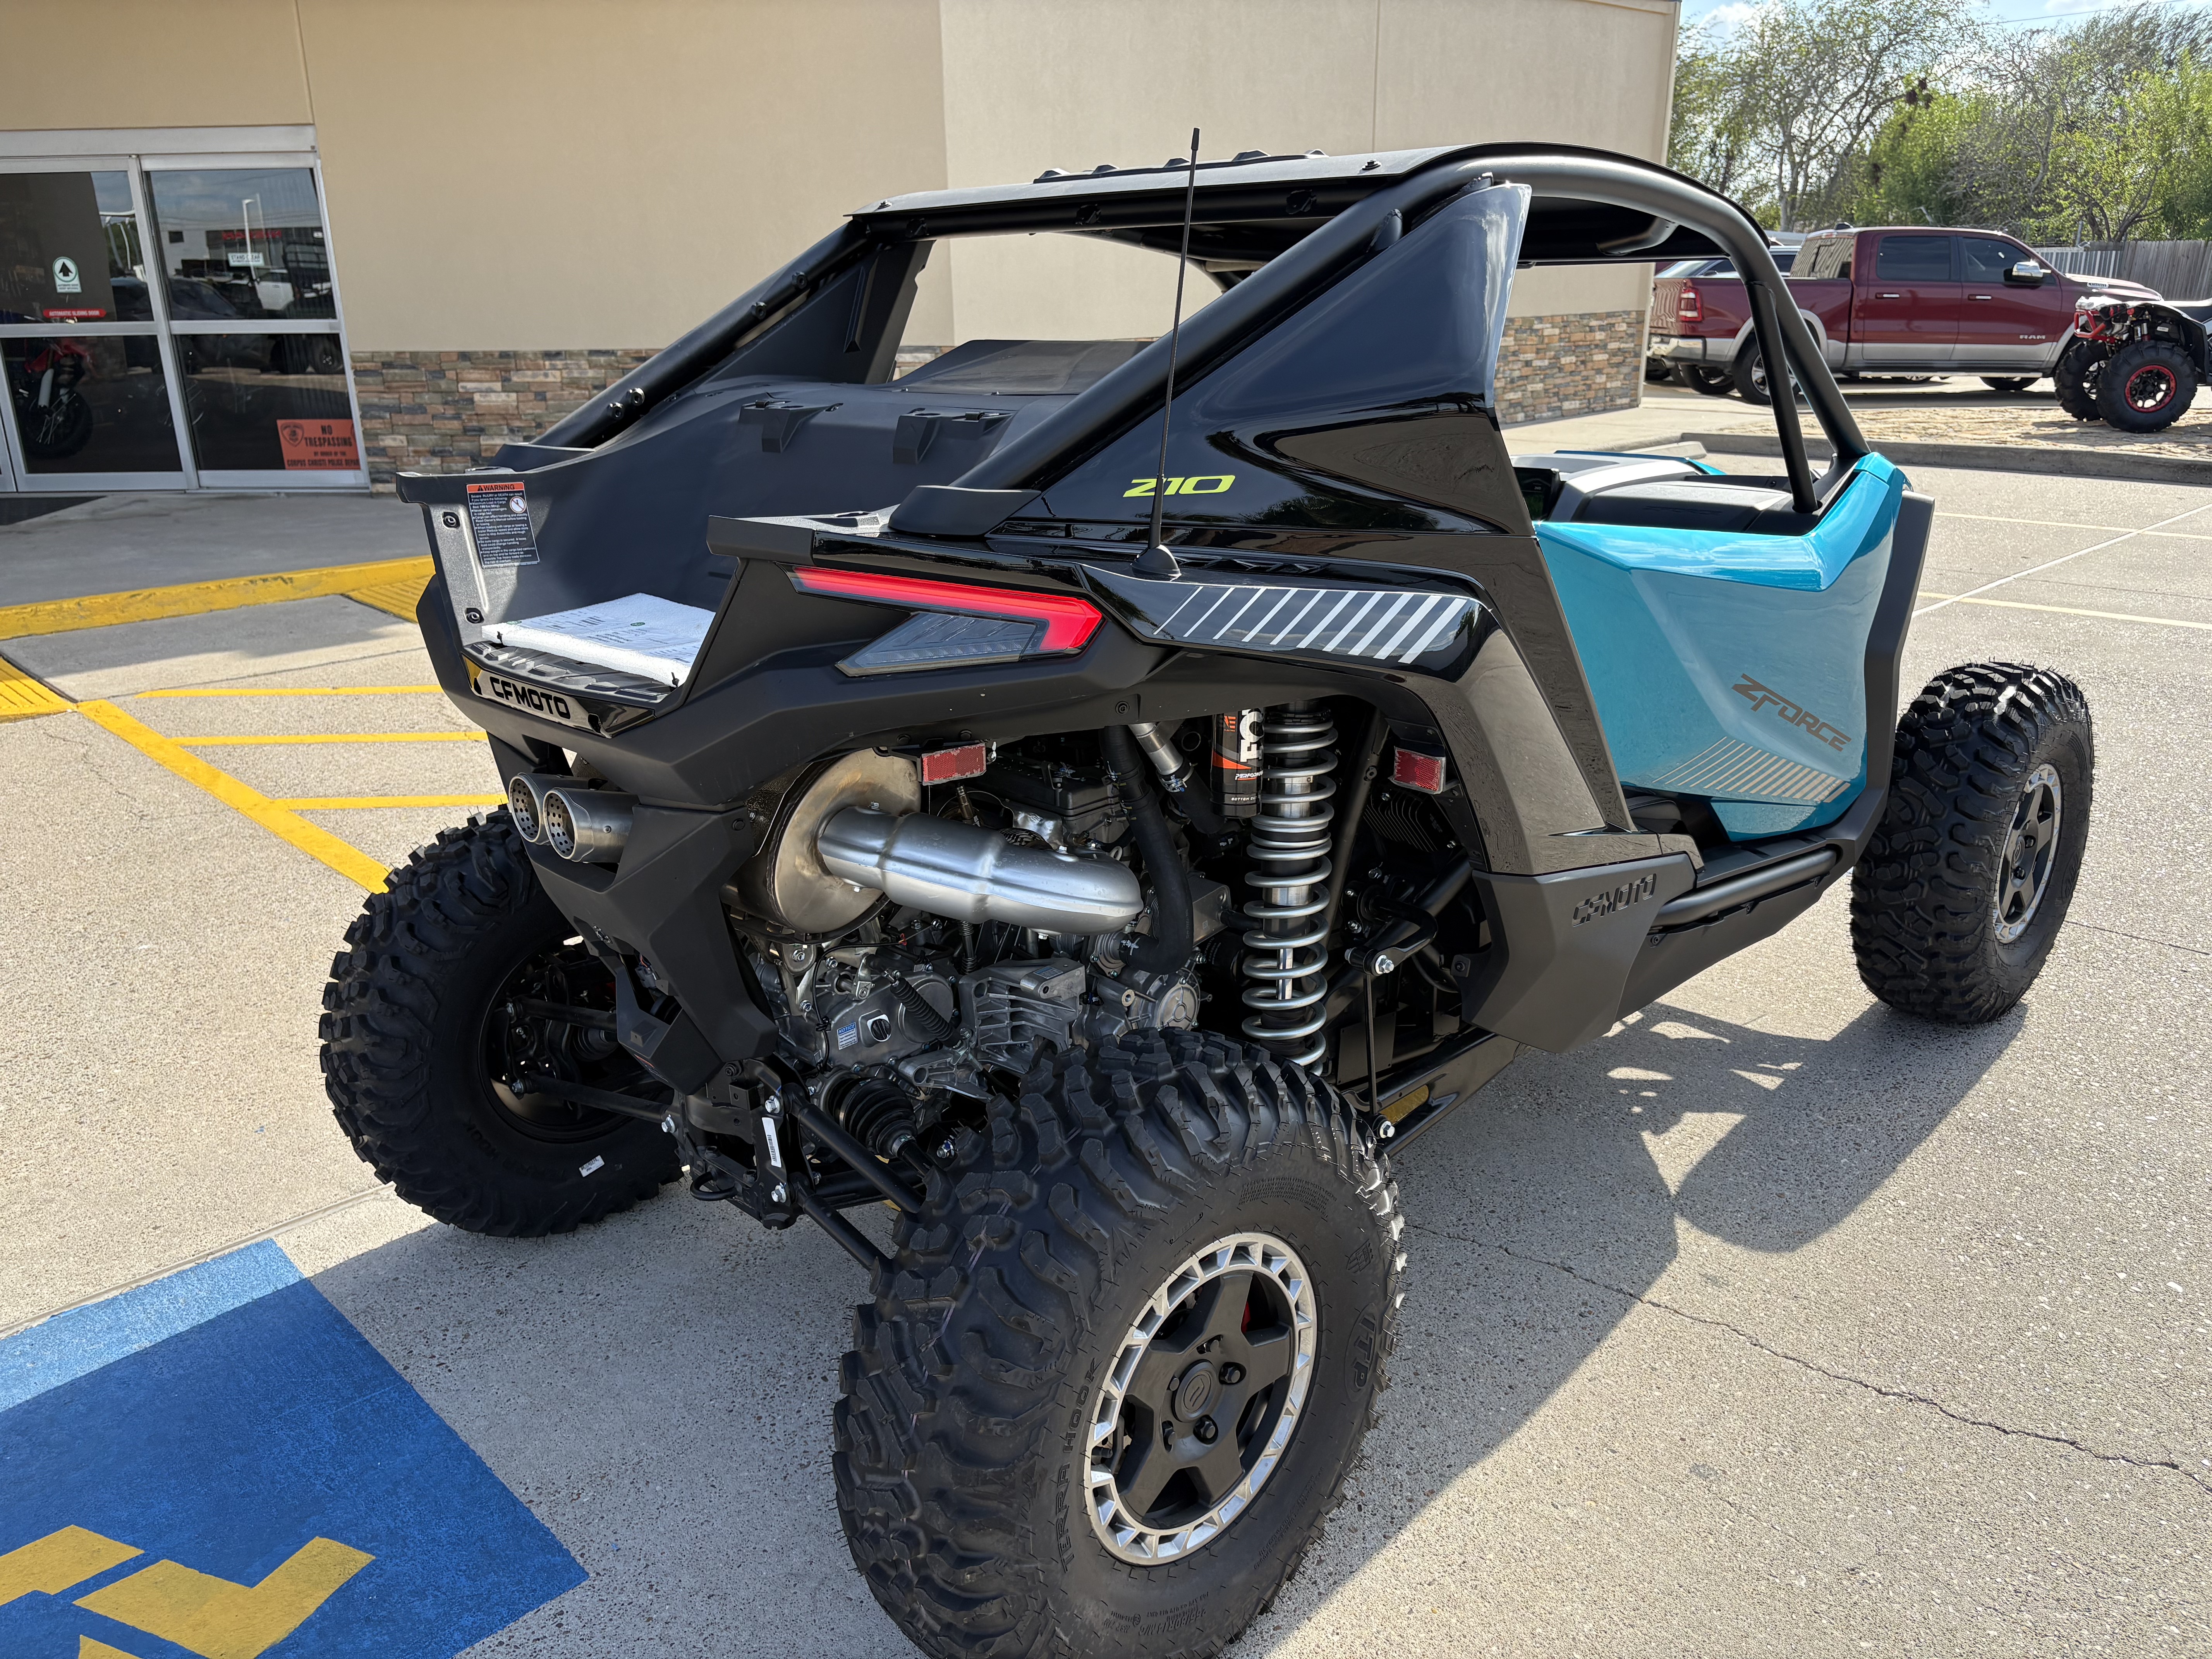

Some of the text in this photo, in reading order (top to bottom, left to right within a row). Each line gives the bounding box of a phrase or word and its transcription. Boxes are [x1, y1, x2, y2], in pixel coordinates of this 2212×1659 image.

[304, 437, 352, 447] TRESPASSING
[321, 425, 333, 435] NO
[1123, 475, 1236, 497] Z10
[489, 676, 570, 719] CFMOTO
[1732, 673, 1851, 752] ZFORCE
[1572, 873, 1656, 927] CFMOTO
[838, 1024, 855, 1034] NOTICE
[1352, 1314, 1376, 1389] ITP
[1056, 1357, 1103, 1573] TERRA HOOK
